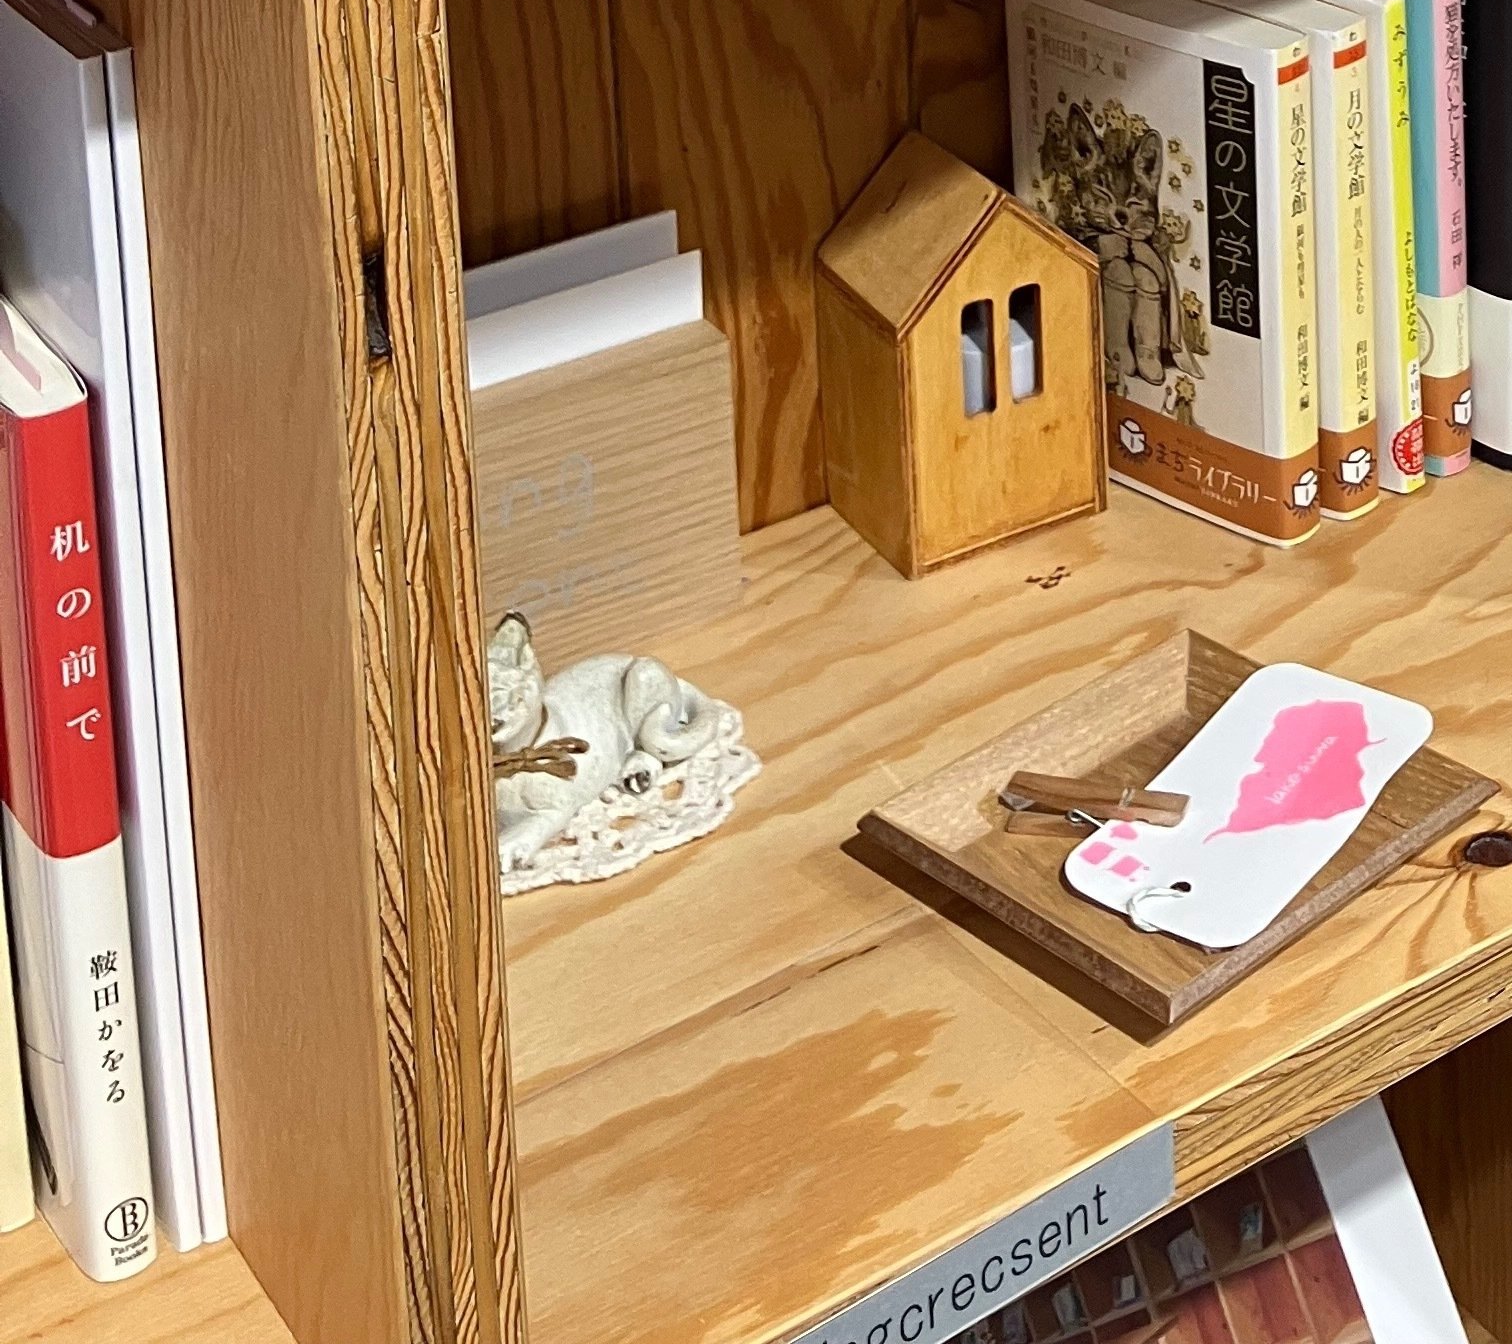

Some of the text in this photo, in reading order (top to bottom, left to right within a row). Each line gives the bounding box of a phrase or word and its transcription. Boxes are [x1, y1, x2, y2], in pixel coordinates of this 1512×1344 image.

[1207, 74, 1256, 329] 星の文学館
[1290, 103, 1308, 218] 星の文学館
[1346, 87, 1366, 200] 月の文学館
[1154, 440, 1278, 505] まちライブラリー
[49, 520, 100, 744] 机の前で
[88, 949, 126, 1104] 鞍田かをる
